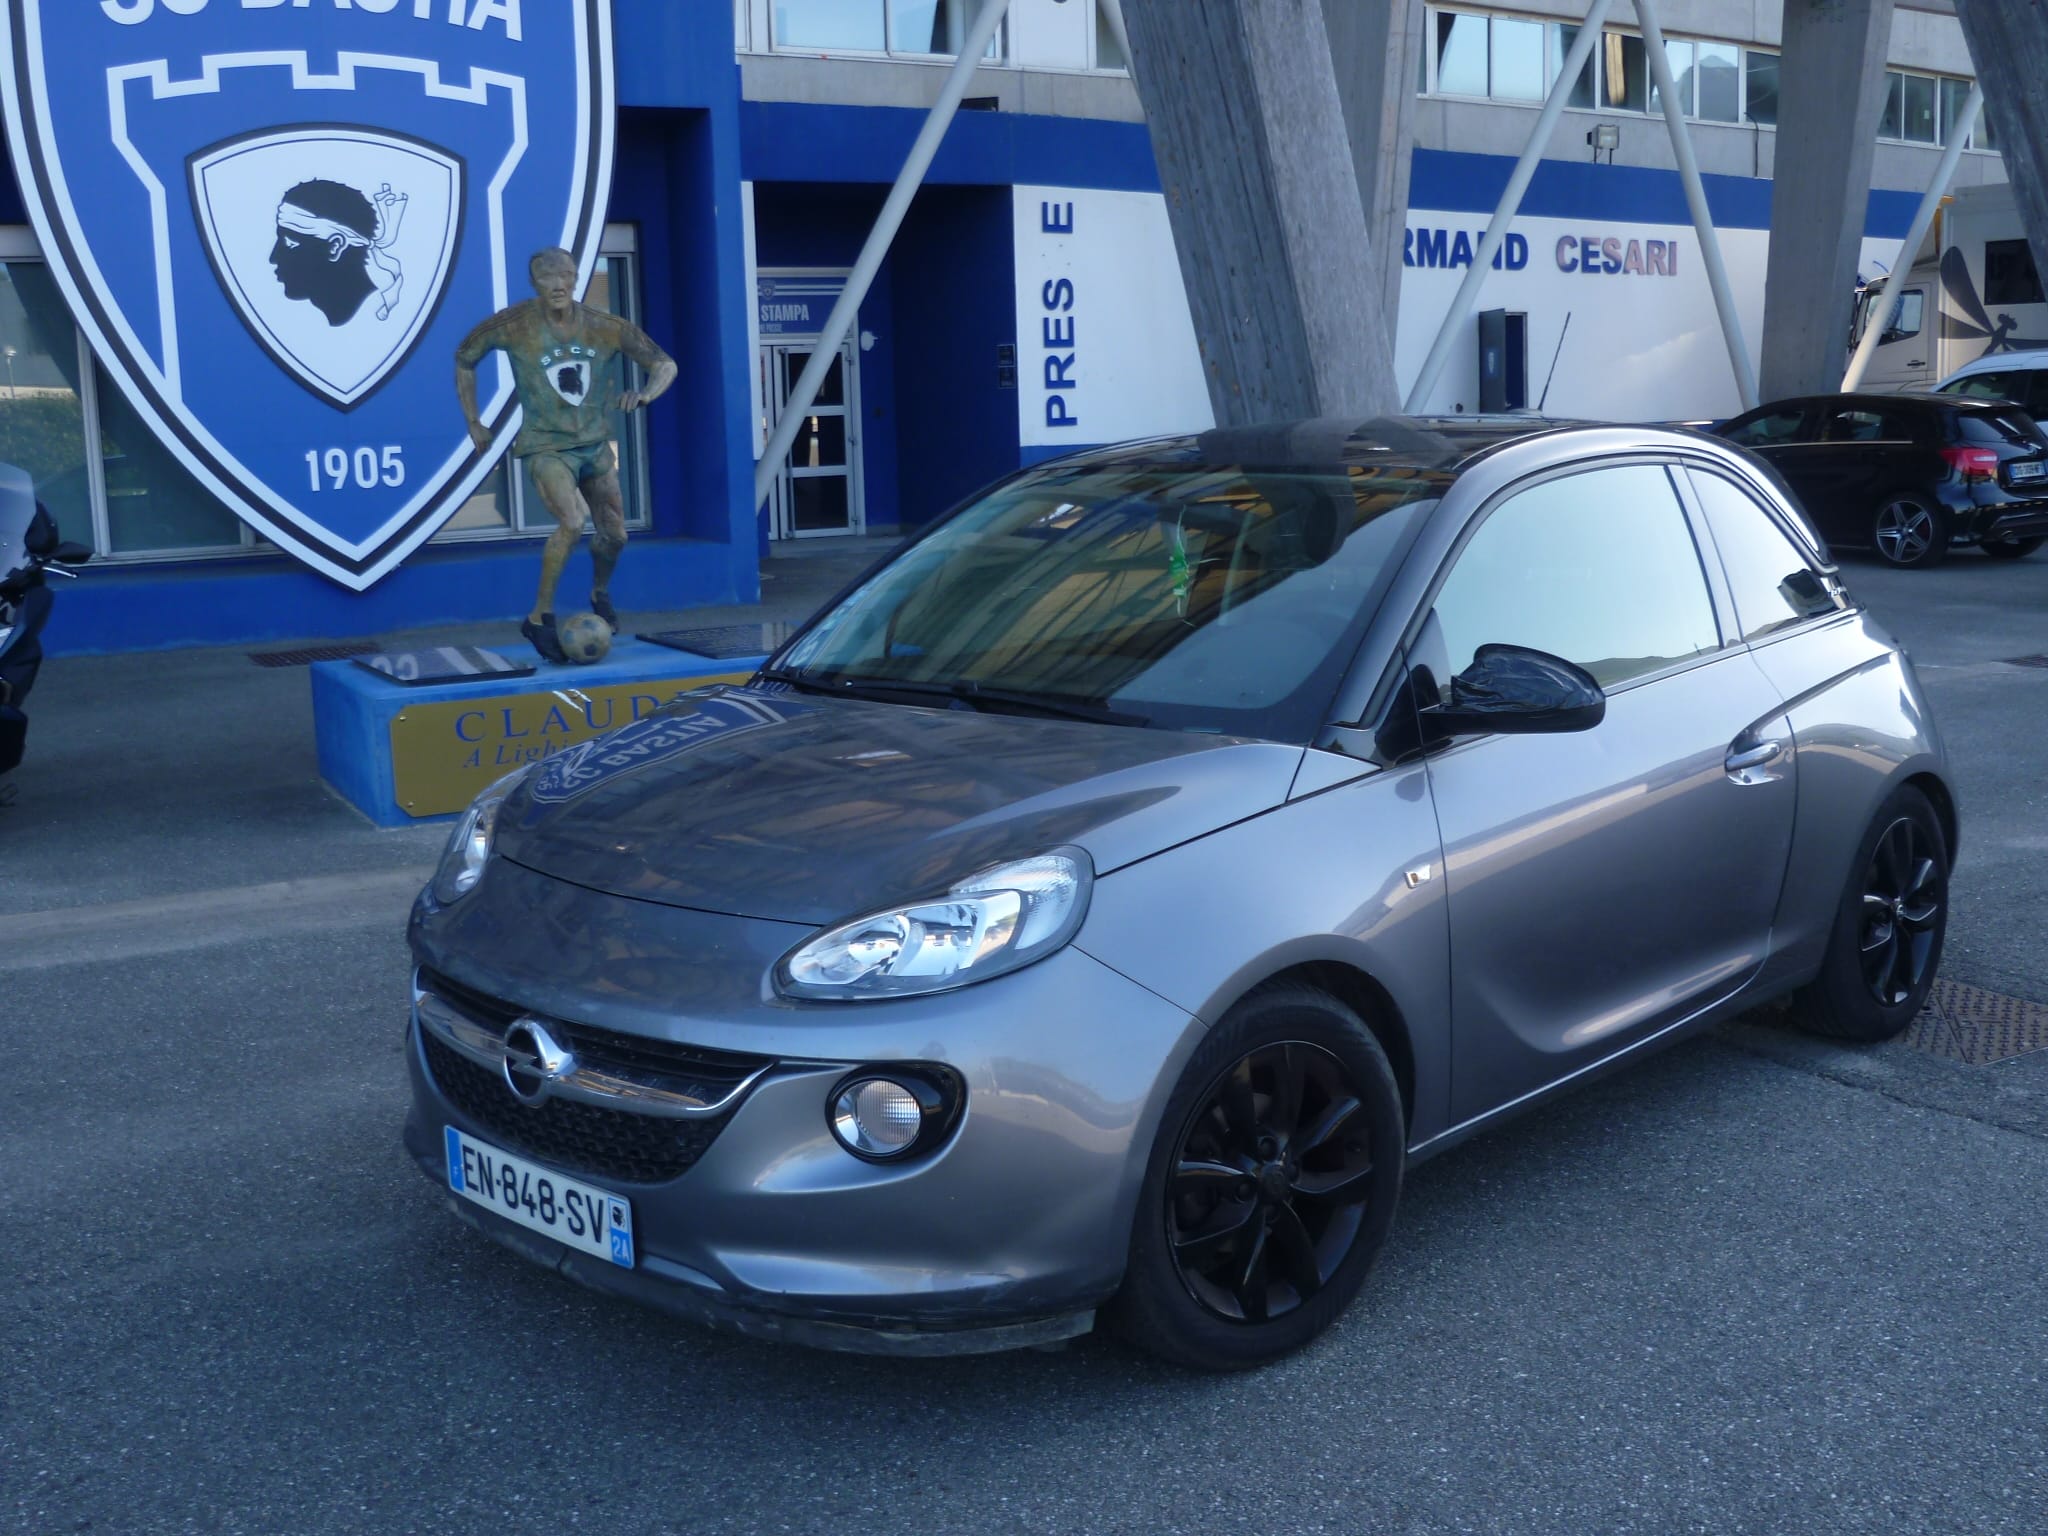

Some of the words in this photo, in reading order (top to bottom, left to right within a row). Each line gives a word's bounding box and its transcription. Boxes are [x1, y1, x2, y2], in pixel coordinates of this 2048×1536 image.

[1403, 227, 1529, 271] RMAD
[1555, 235, 1678, 276] CESARI
[761, 304, 810, 321] STAMPA
[1041, 277, 1078, 428] PRES
[305, 445, 405, 492] 1905
[455, 690, 691, 743] CLAUD
[463, 747, 481, 769] A
[462, 1144, 604, 1244] EN-848-SV
[612, 1235, 632, 1264] 2A
